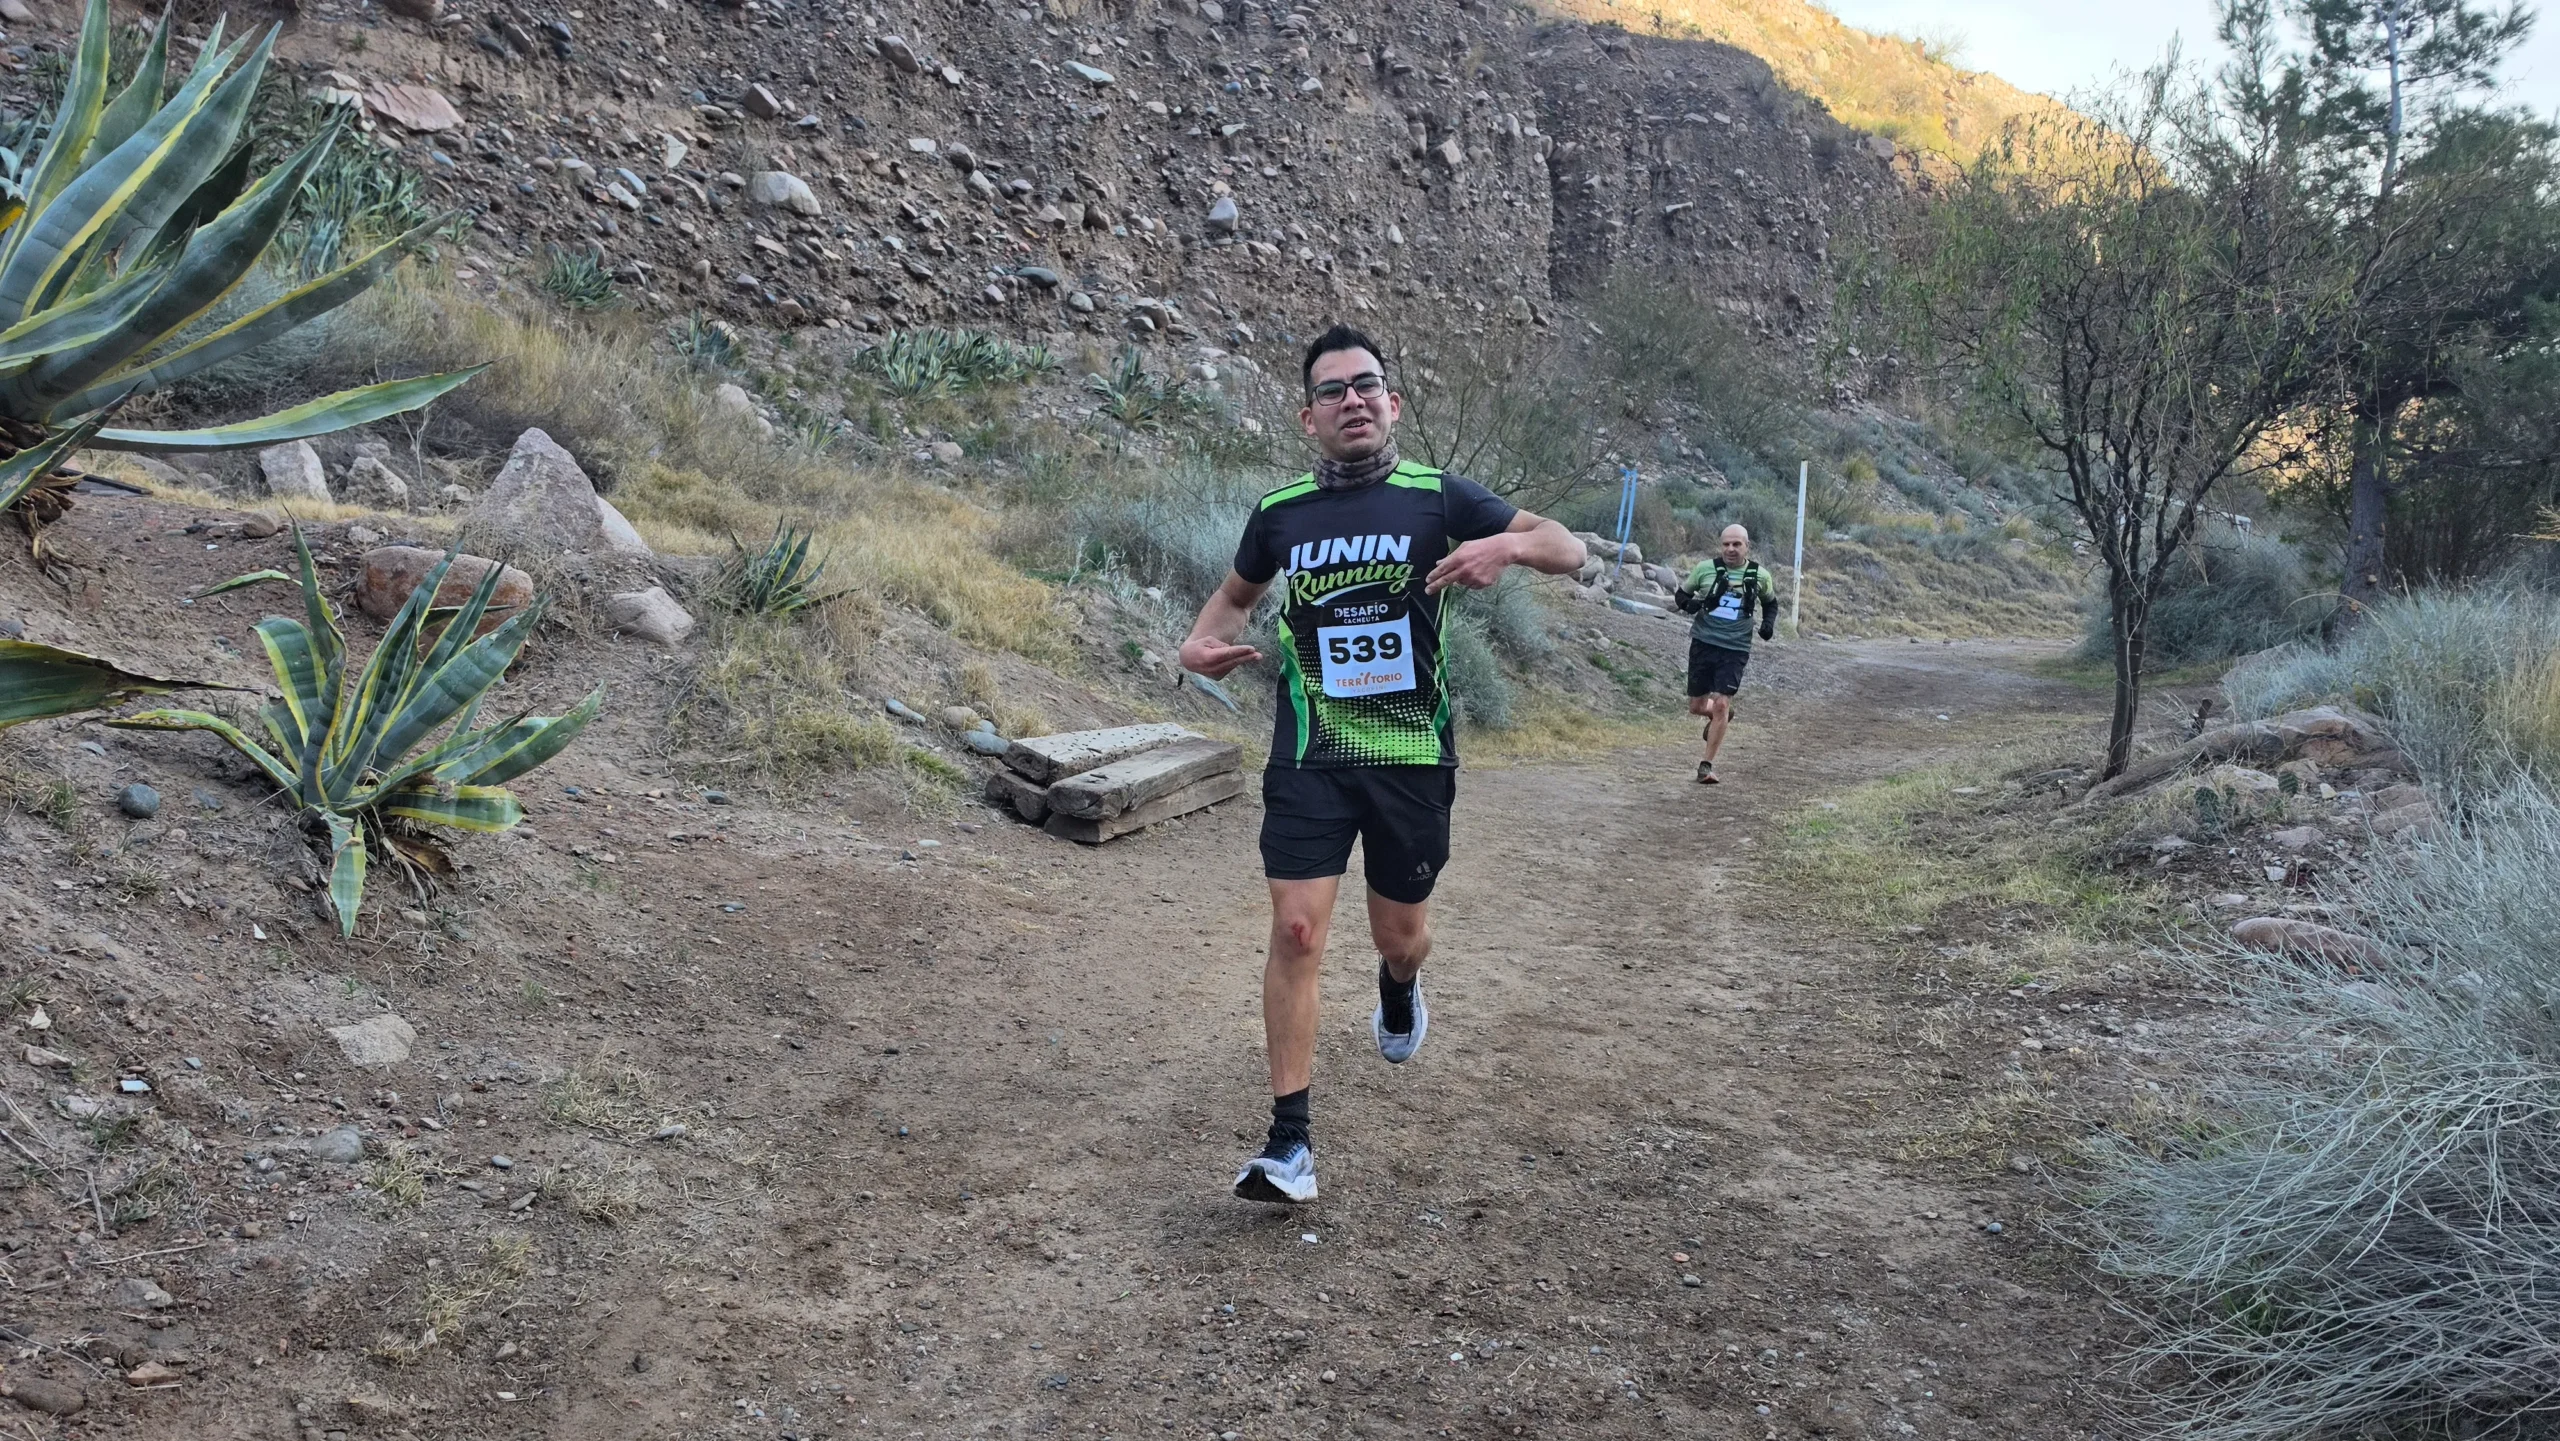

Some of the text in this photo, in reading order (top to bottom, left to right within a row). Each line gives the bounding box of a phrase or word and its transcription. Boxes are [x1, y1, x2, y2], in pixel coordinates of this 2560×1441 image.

[1286, 535, 1411, 576] JUNIN
[1291, 559, 1414, 605] Running
[1343, 616, 1380, 624] CACHEUTA
[1328, 632, 1402, 664] 539
[1336, 672, 1402, 687] TERRITORIO
